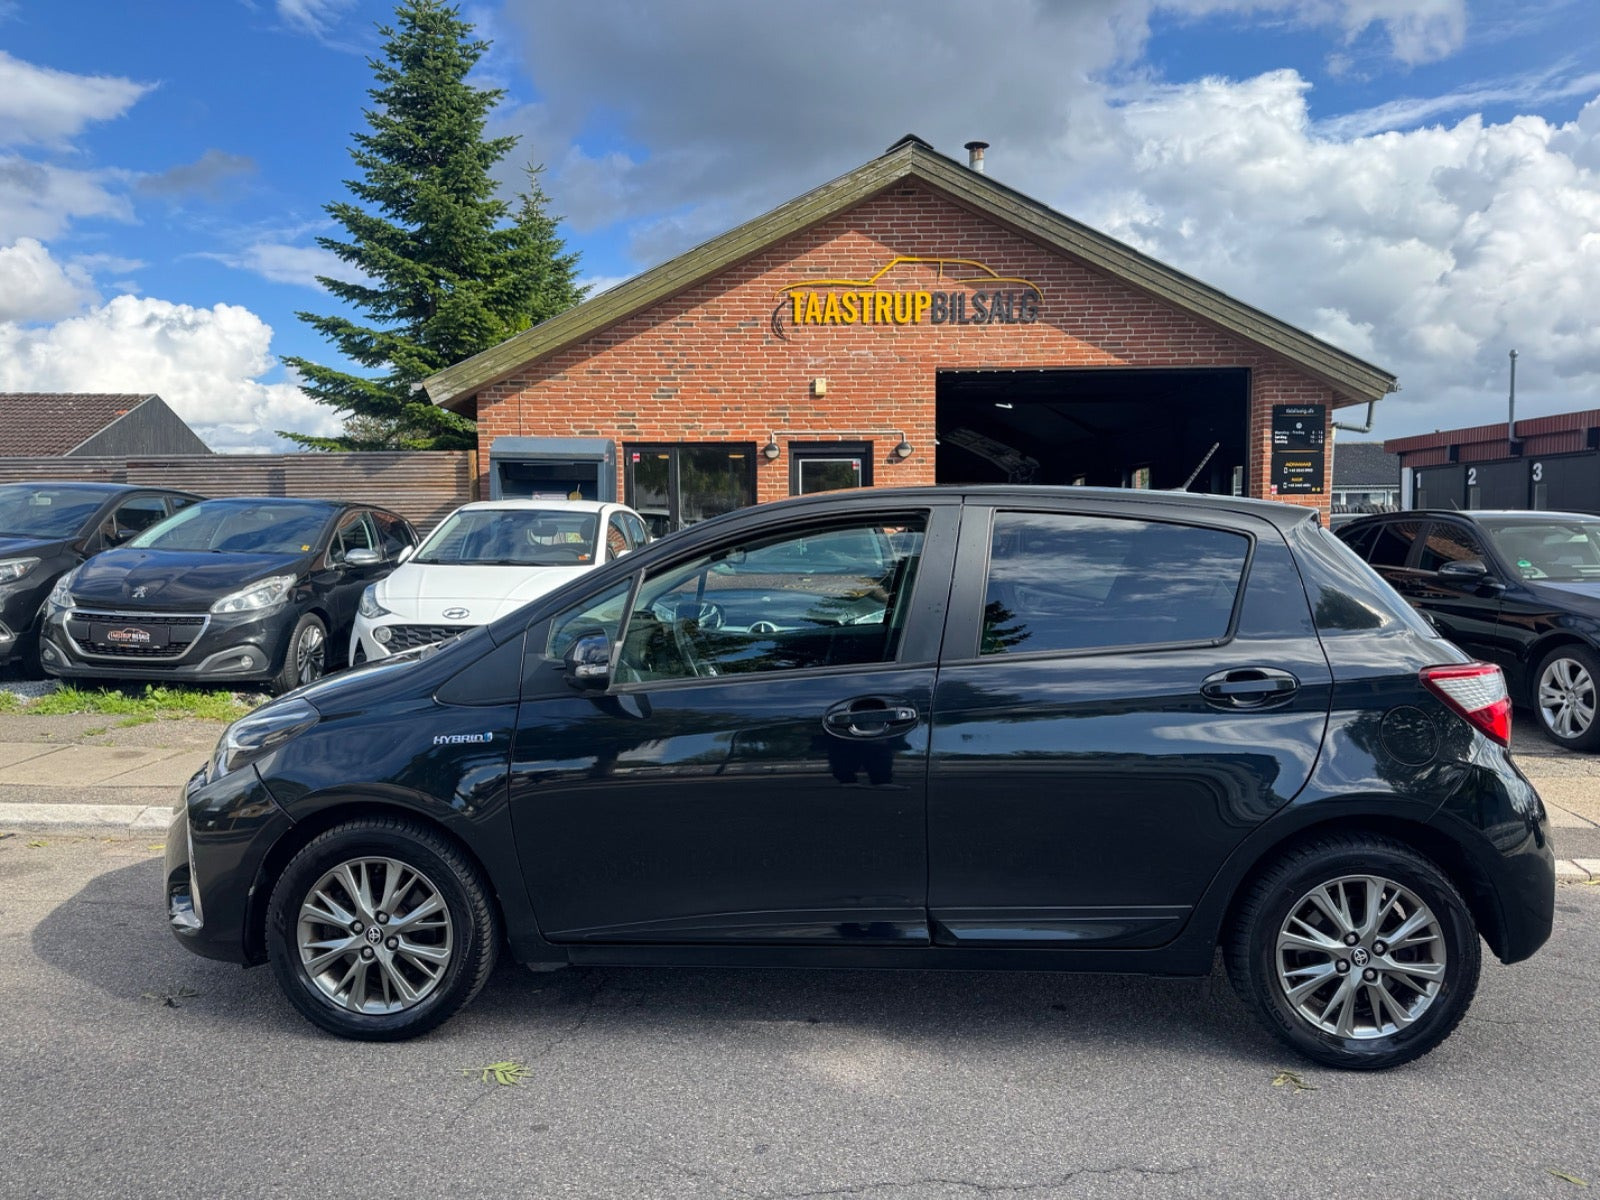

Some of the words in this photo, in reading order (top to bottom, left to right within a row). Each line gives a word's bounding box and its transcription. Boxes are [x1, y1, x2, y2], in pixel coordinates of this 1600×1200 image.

[1415, 472, 1422, 489] 1
[1467, 467, 1477, 486] 2
[1532, 462, 1543, 482] 3
[433, 734, 484, 744] HYBRID
